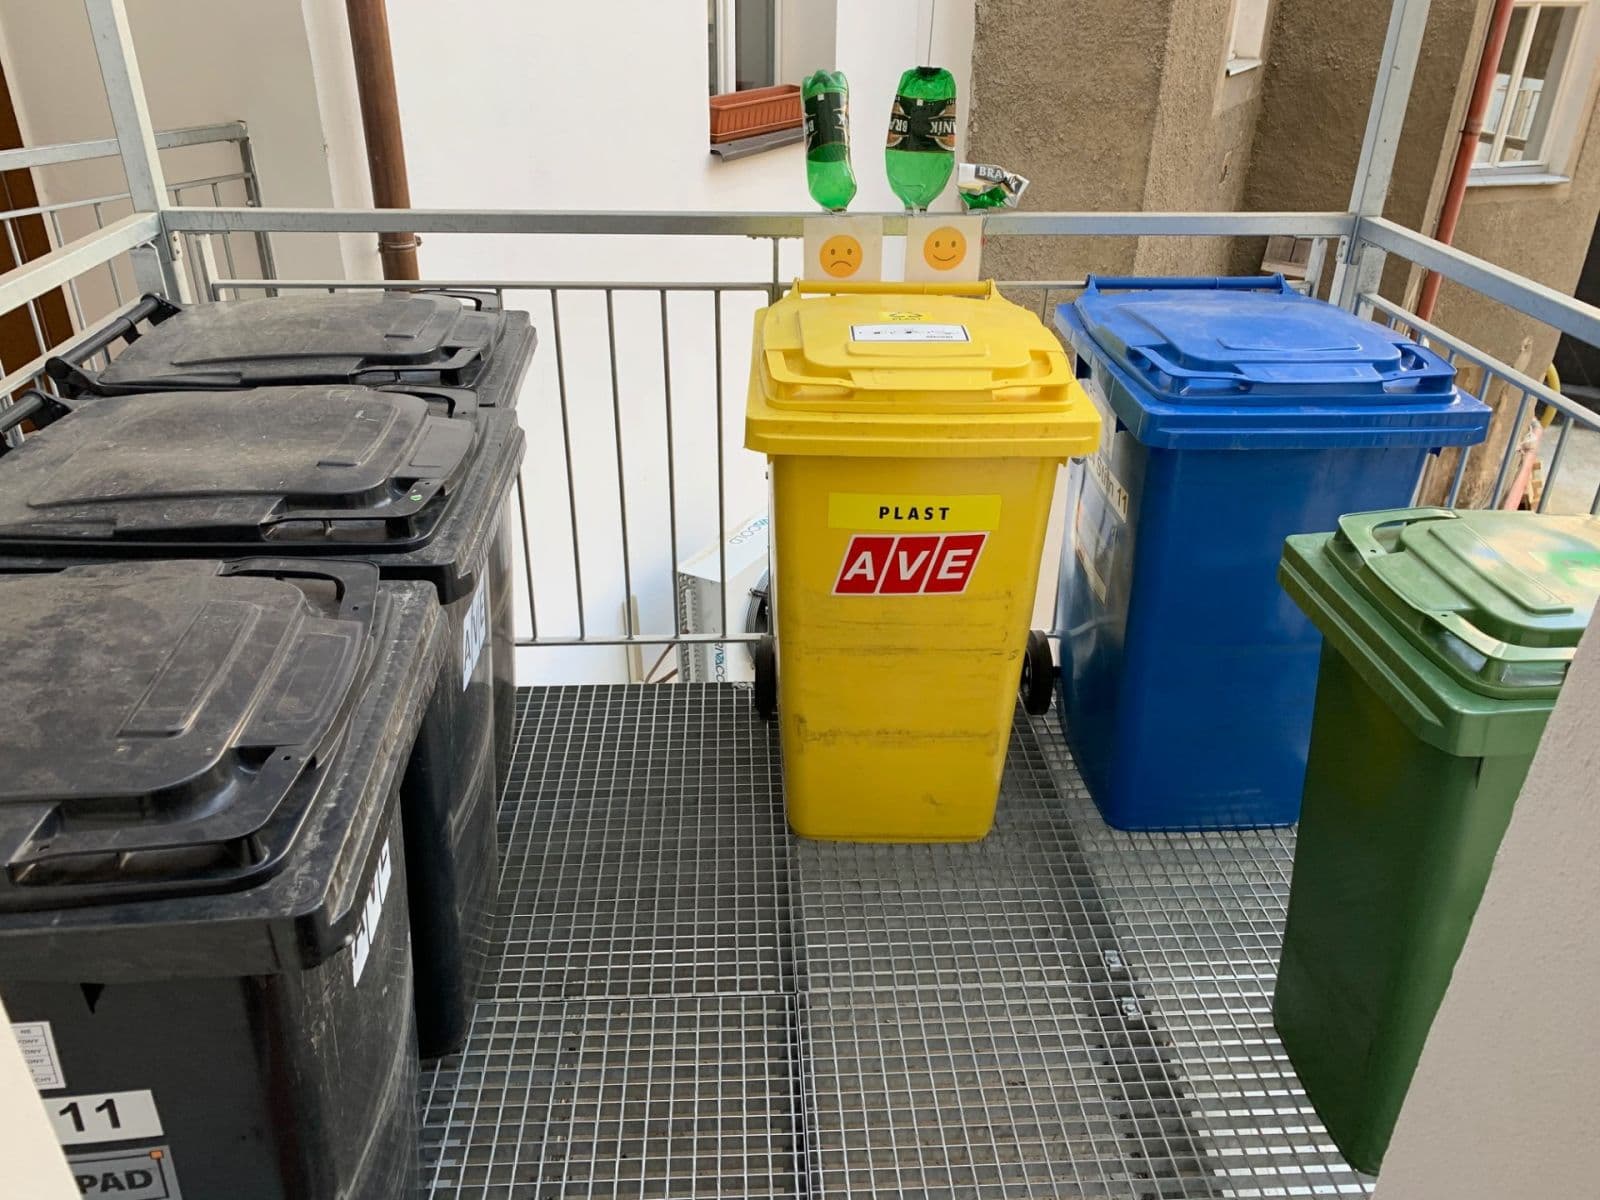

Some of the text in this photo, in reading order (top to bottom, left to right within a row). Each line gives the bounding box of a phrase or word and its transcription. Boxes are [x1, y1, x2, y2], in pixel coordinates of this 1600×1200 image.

[879, 506, 950, 521] PLAST
[842, 548, 974, 581] AVE
[58, 1097, 122, 1133] 11
